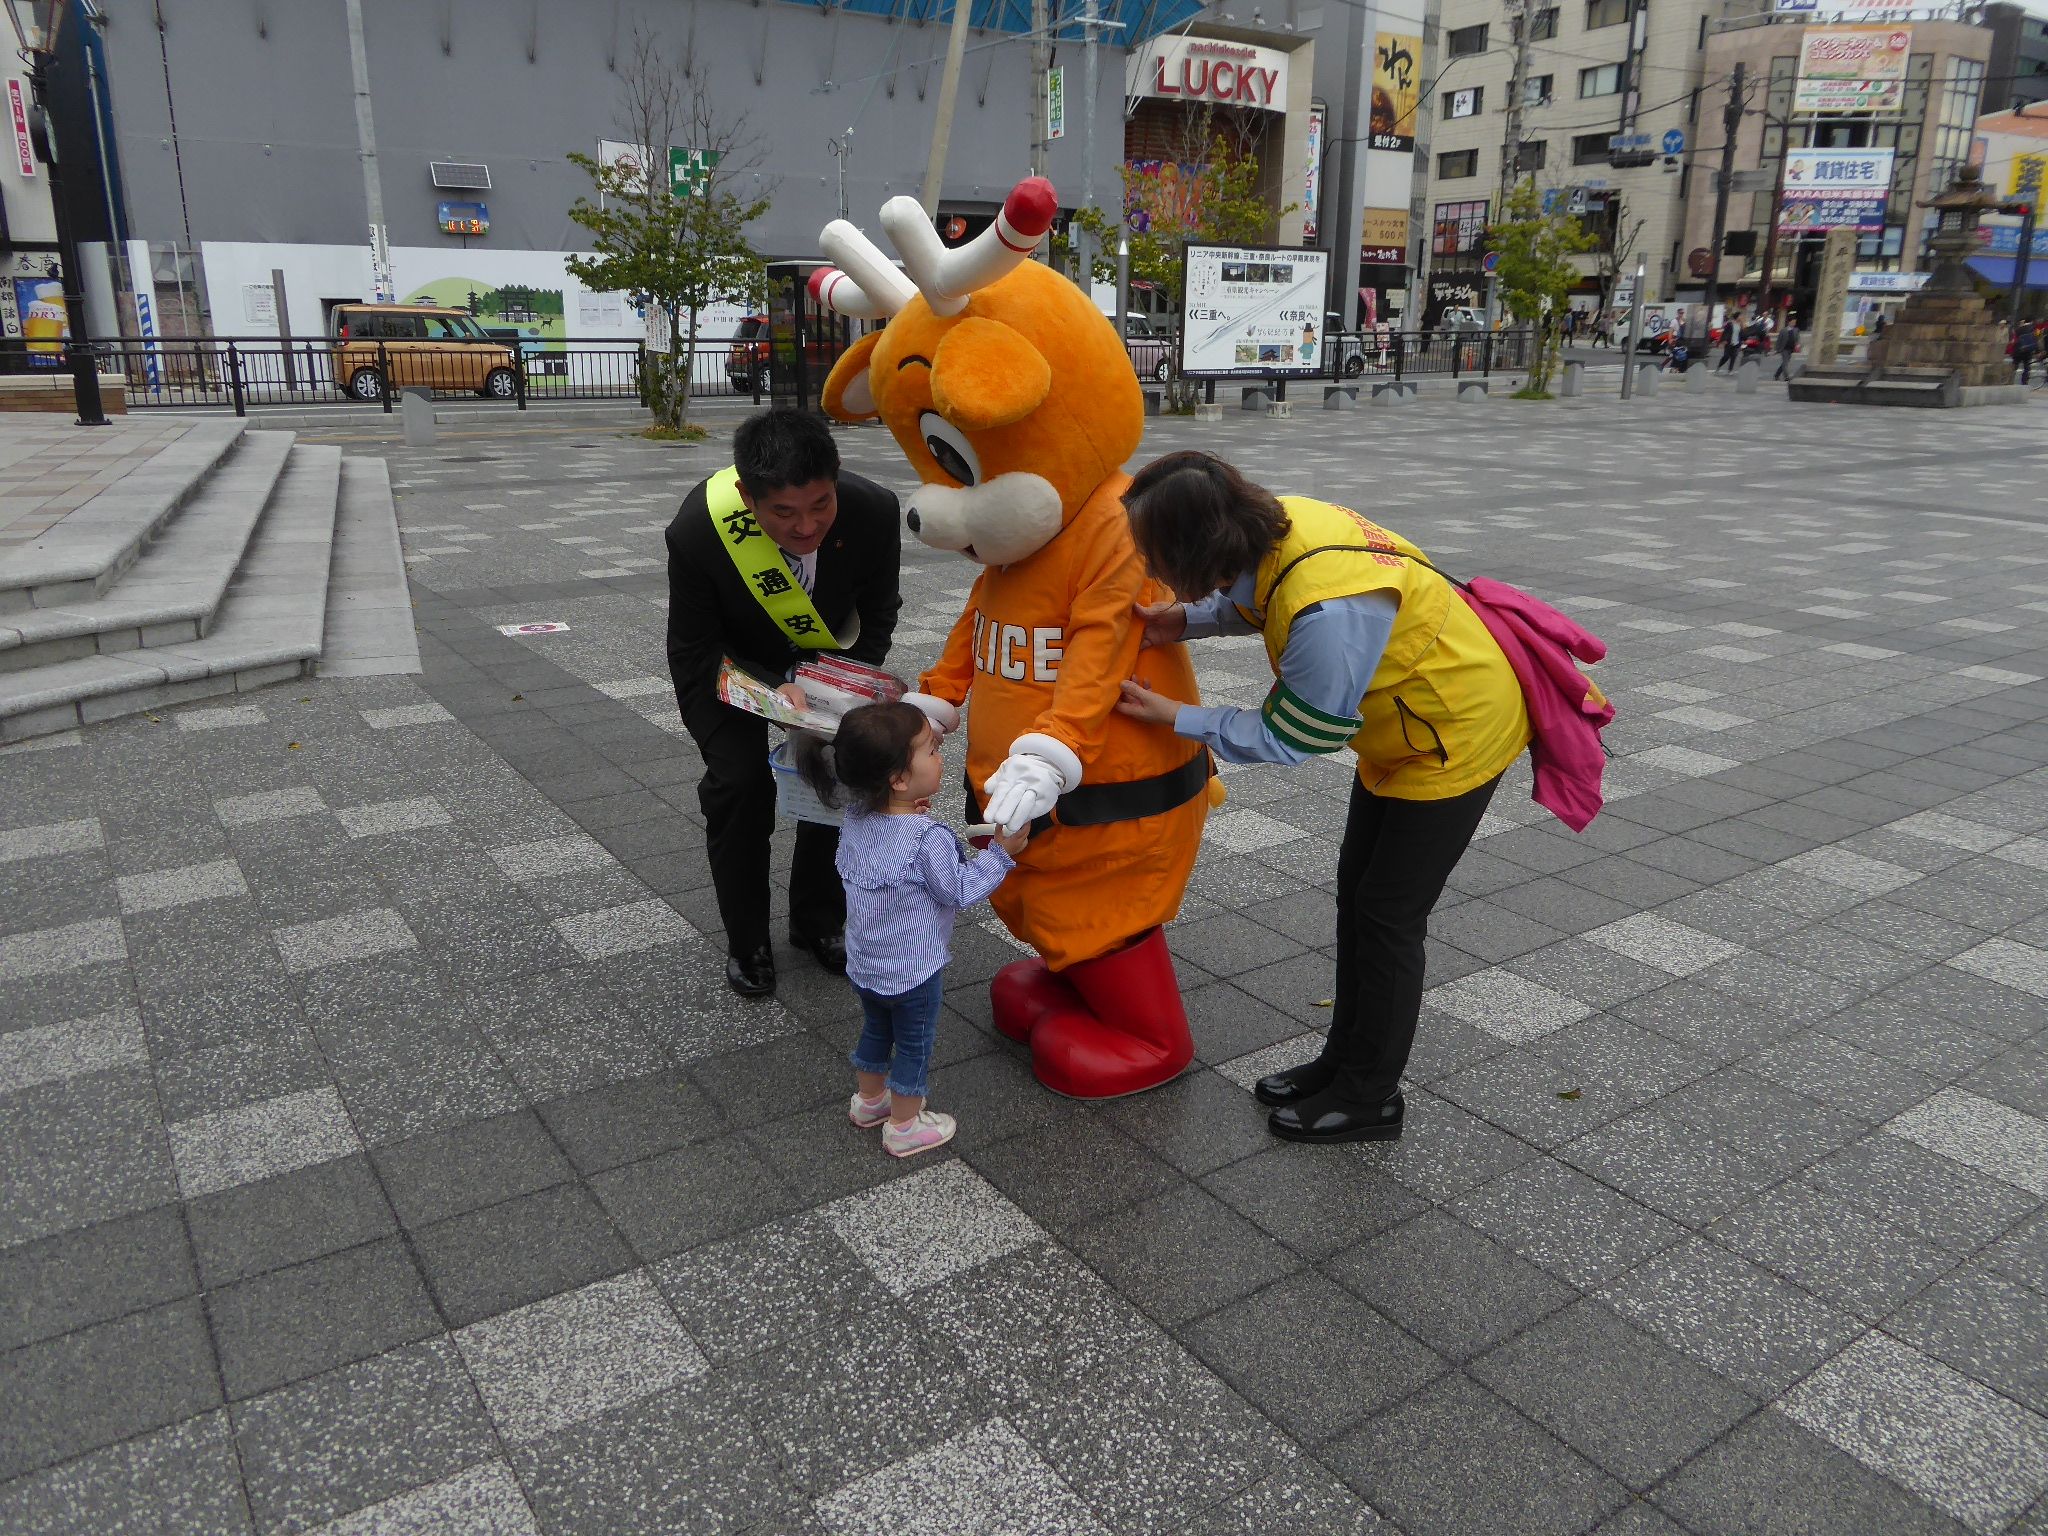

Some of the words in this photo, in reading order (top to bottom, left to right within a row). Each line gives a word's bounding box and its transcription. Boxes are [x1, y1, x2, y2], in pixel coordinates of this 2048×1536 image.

[1378, 37, 1413, 90] わん
[1156, 56, 1279, 105] LUCKY
[1814, 160, 1875, 180] 賃貸住宅
[1860, 276, 1896, 286] 賃貸住宅
[30, 311, 57, 319] DRY
[1200, 309, 1231, 321] 三重へ。
[1289, 310, 1318, 322] 奈良へ。
[721, 508, 820, 635] 交通安
[972, 609, 1065, 682] LICE
